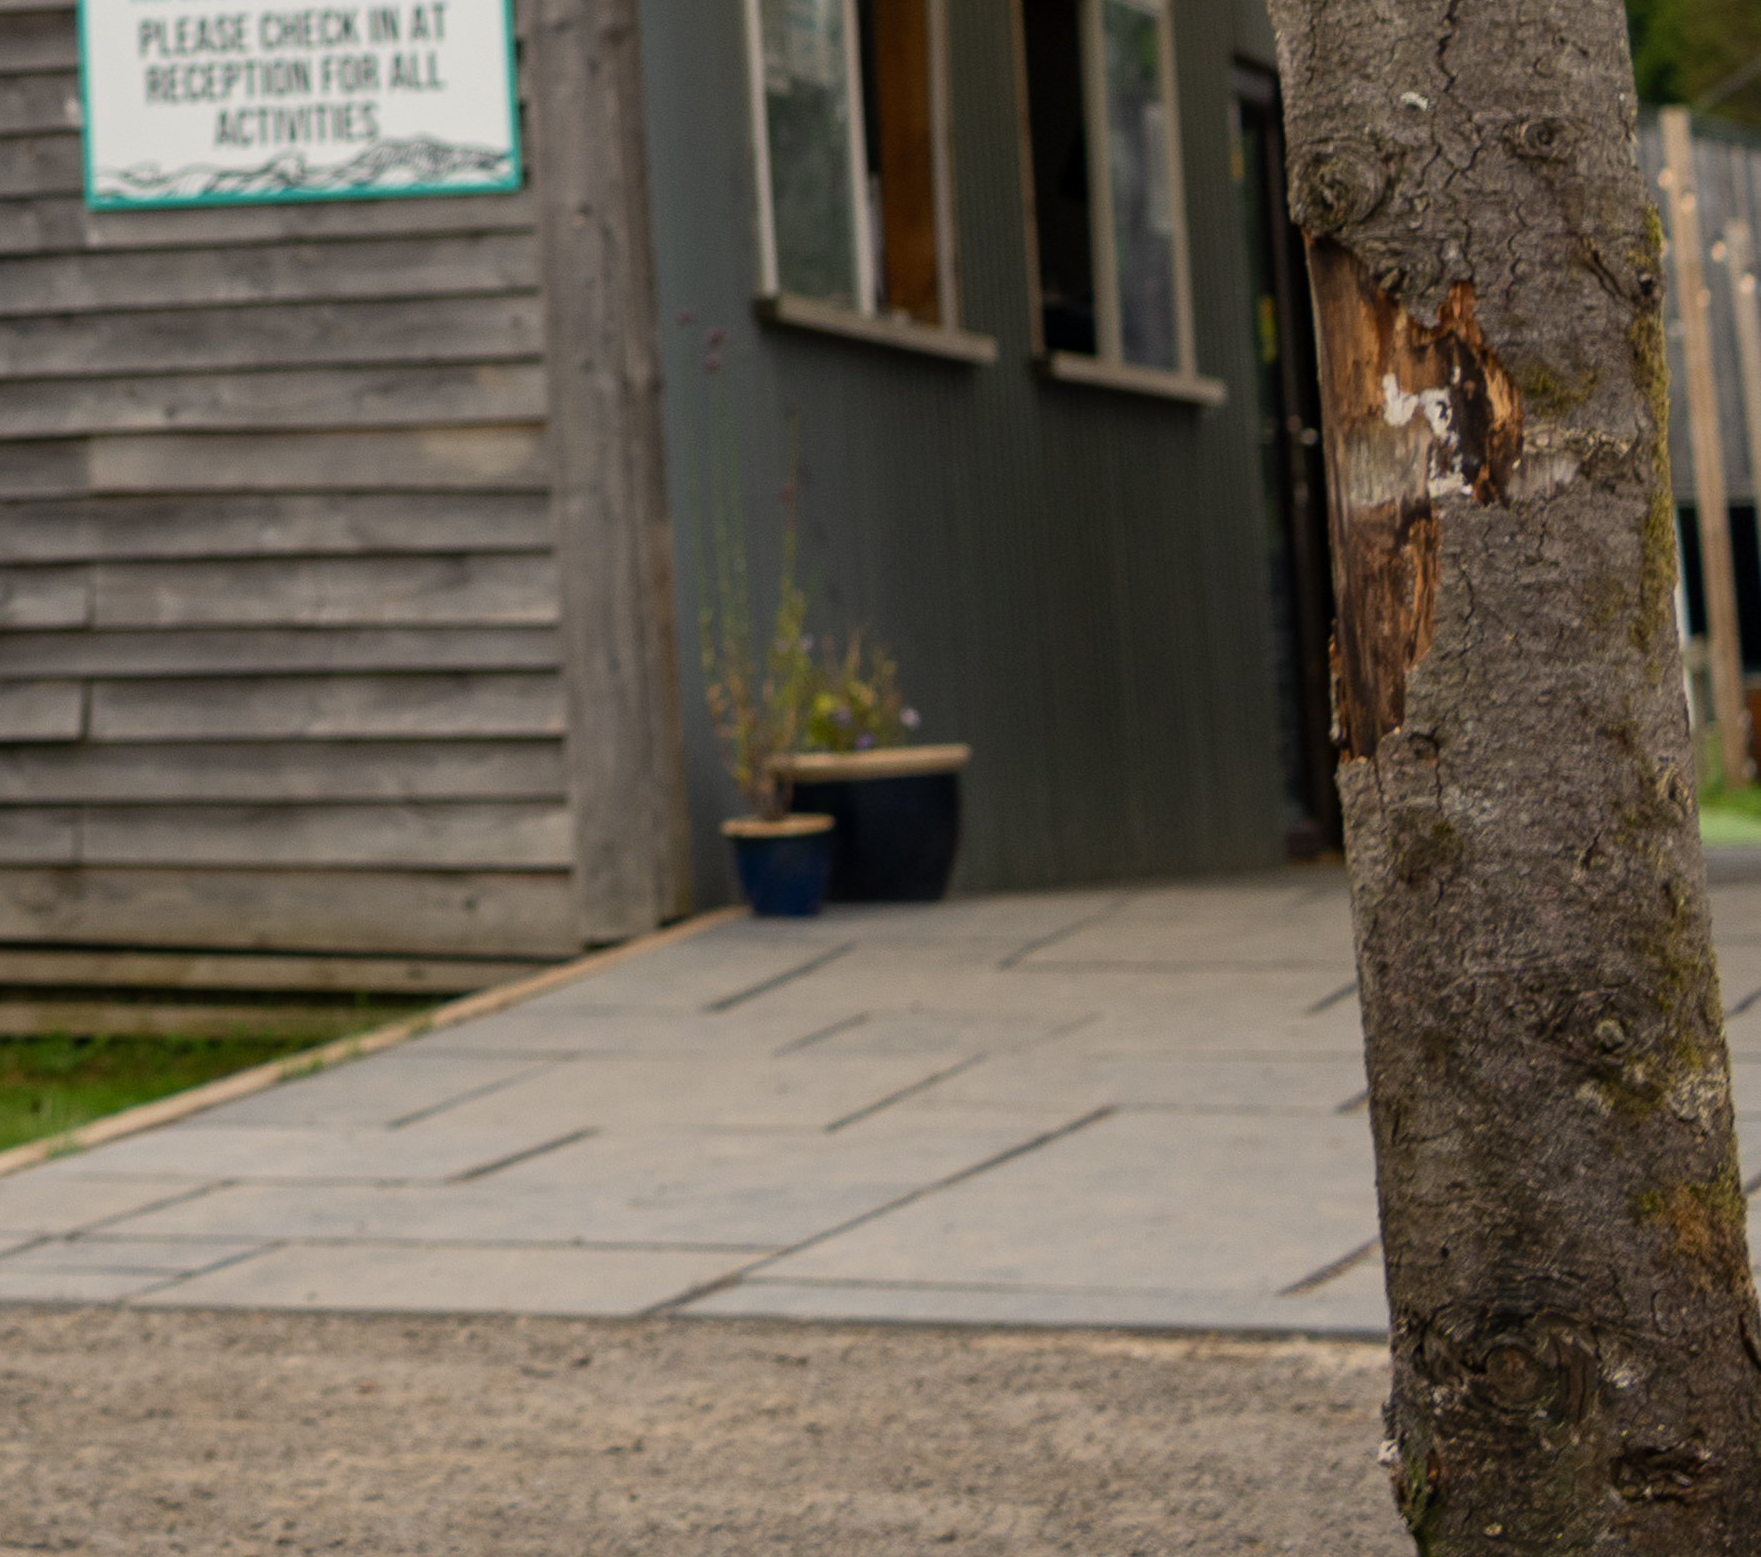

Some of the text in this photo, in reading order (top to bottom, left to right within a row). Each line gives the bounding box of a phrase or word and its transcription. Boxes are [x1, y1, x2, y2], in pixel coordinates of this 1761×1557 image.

[139, 1, 448, 57] PLEASE CHECK IN AT
[145, 51, 445, 103] RECEPTION FOR ALL
[215, 103, 379, 146] ACTIVITIES
